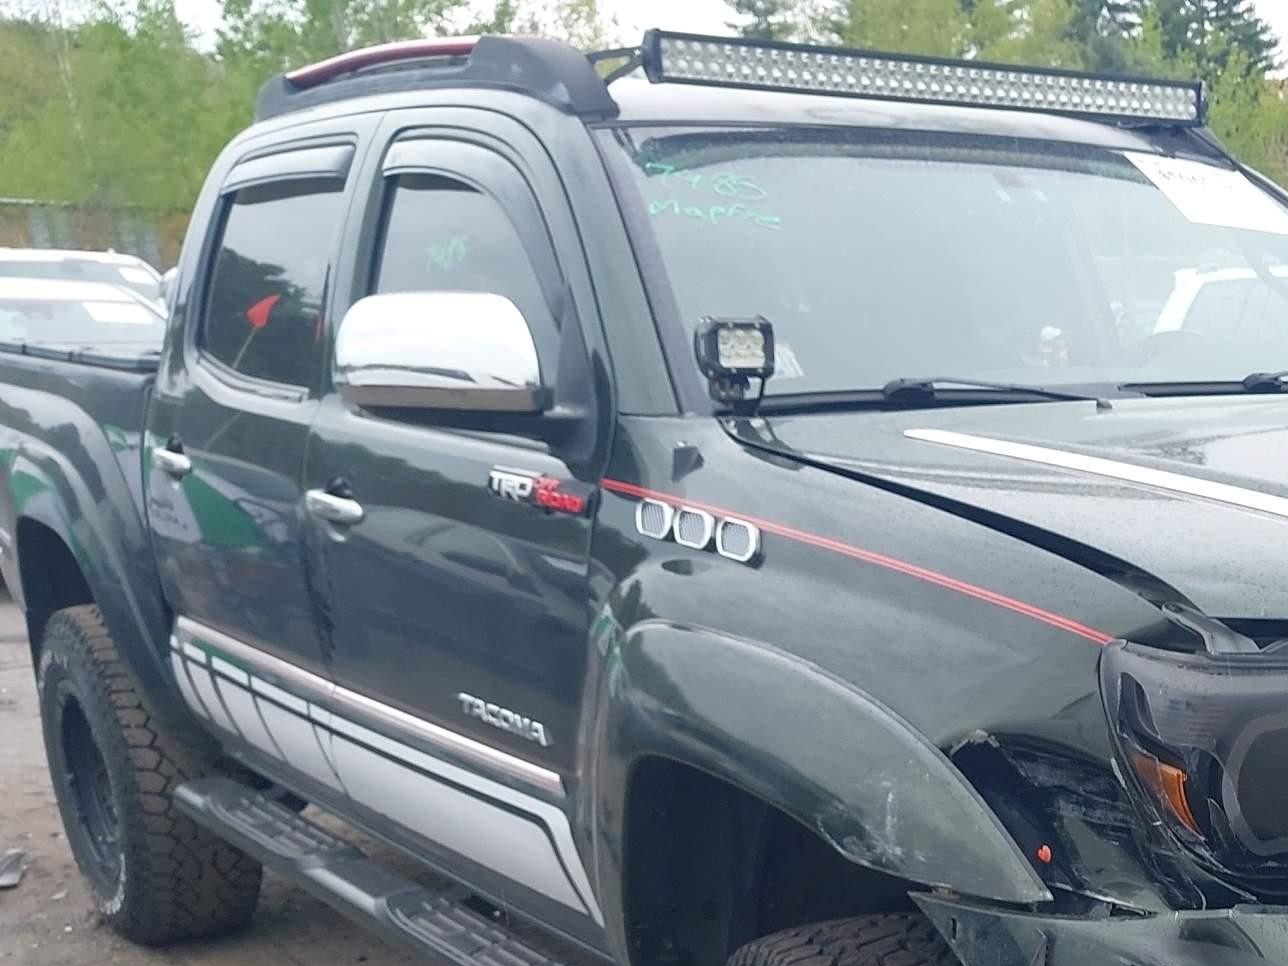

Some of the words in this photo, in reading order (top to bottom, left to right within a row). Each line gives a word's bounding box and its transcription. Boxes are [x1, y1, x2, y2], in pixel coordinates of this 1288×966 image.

[489, 470, 534, 502] TRD
[537, 489, 584, 512] ROAD
[458, 692, 549, 746] TACOMA
